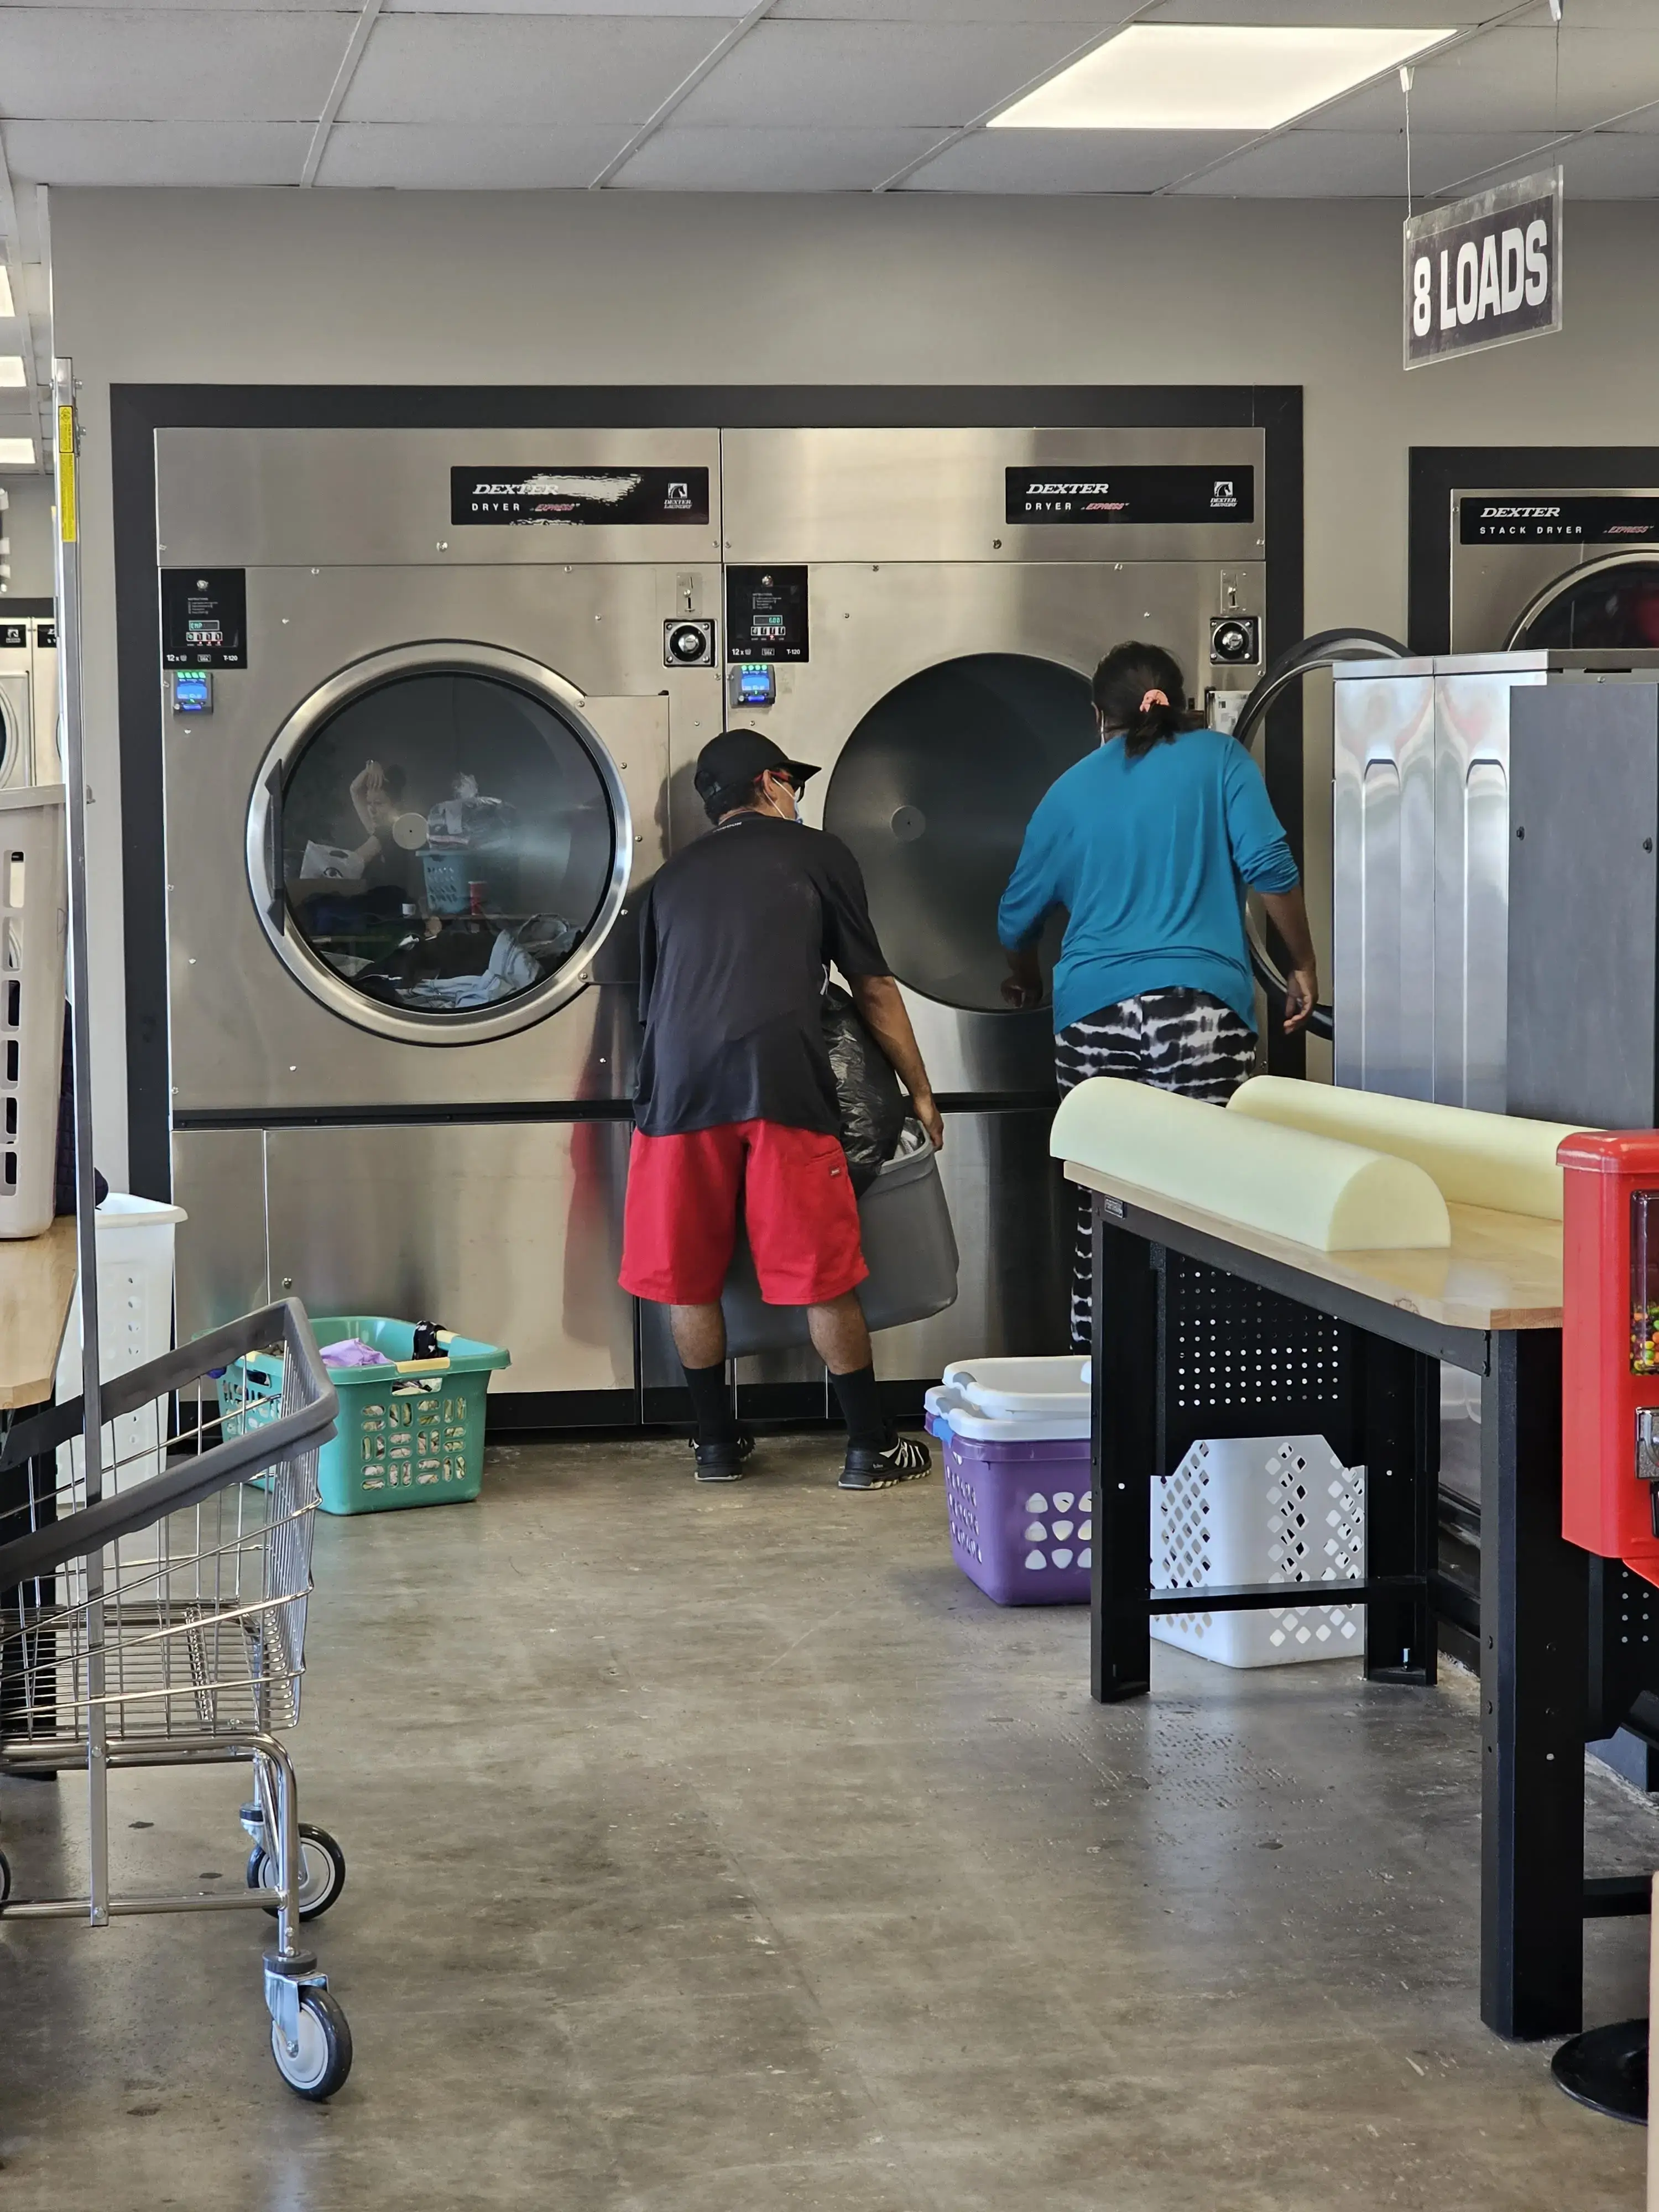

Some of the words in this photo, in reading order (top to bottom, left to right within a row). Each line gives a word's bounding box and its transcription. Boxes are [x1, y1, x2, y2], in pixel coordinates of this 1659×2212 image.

[1413, 257, 1431, 337] 8
[1440, 220, 1548, 331] LOADS
[472, 484, 559, 495] DEXTER
[1026, 483, 1109, 494] DEXTER
[472, 503, 520, 512] DRYER
[1480, 507, 1561, 518] DEXTER
[1480, 526, 1526, 535] STACK
[1537, 526, 1582, 534] DRYER
